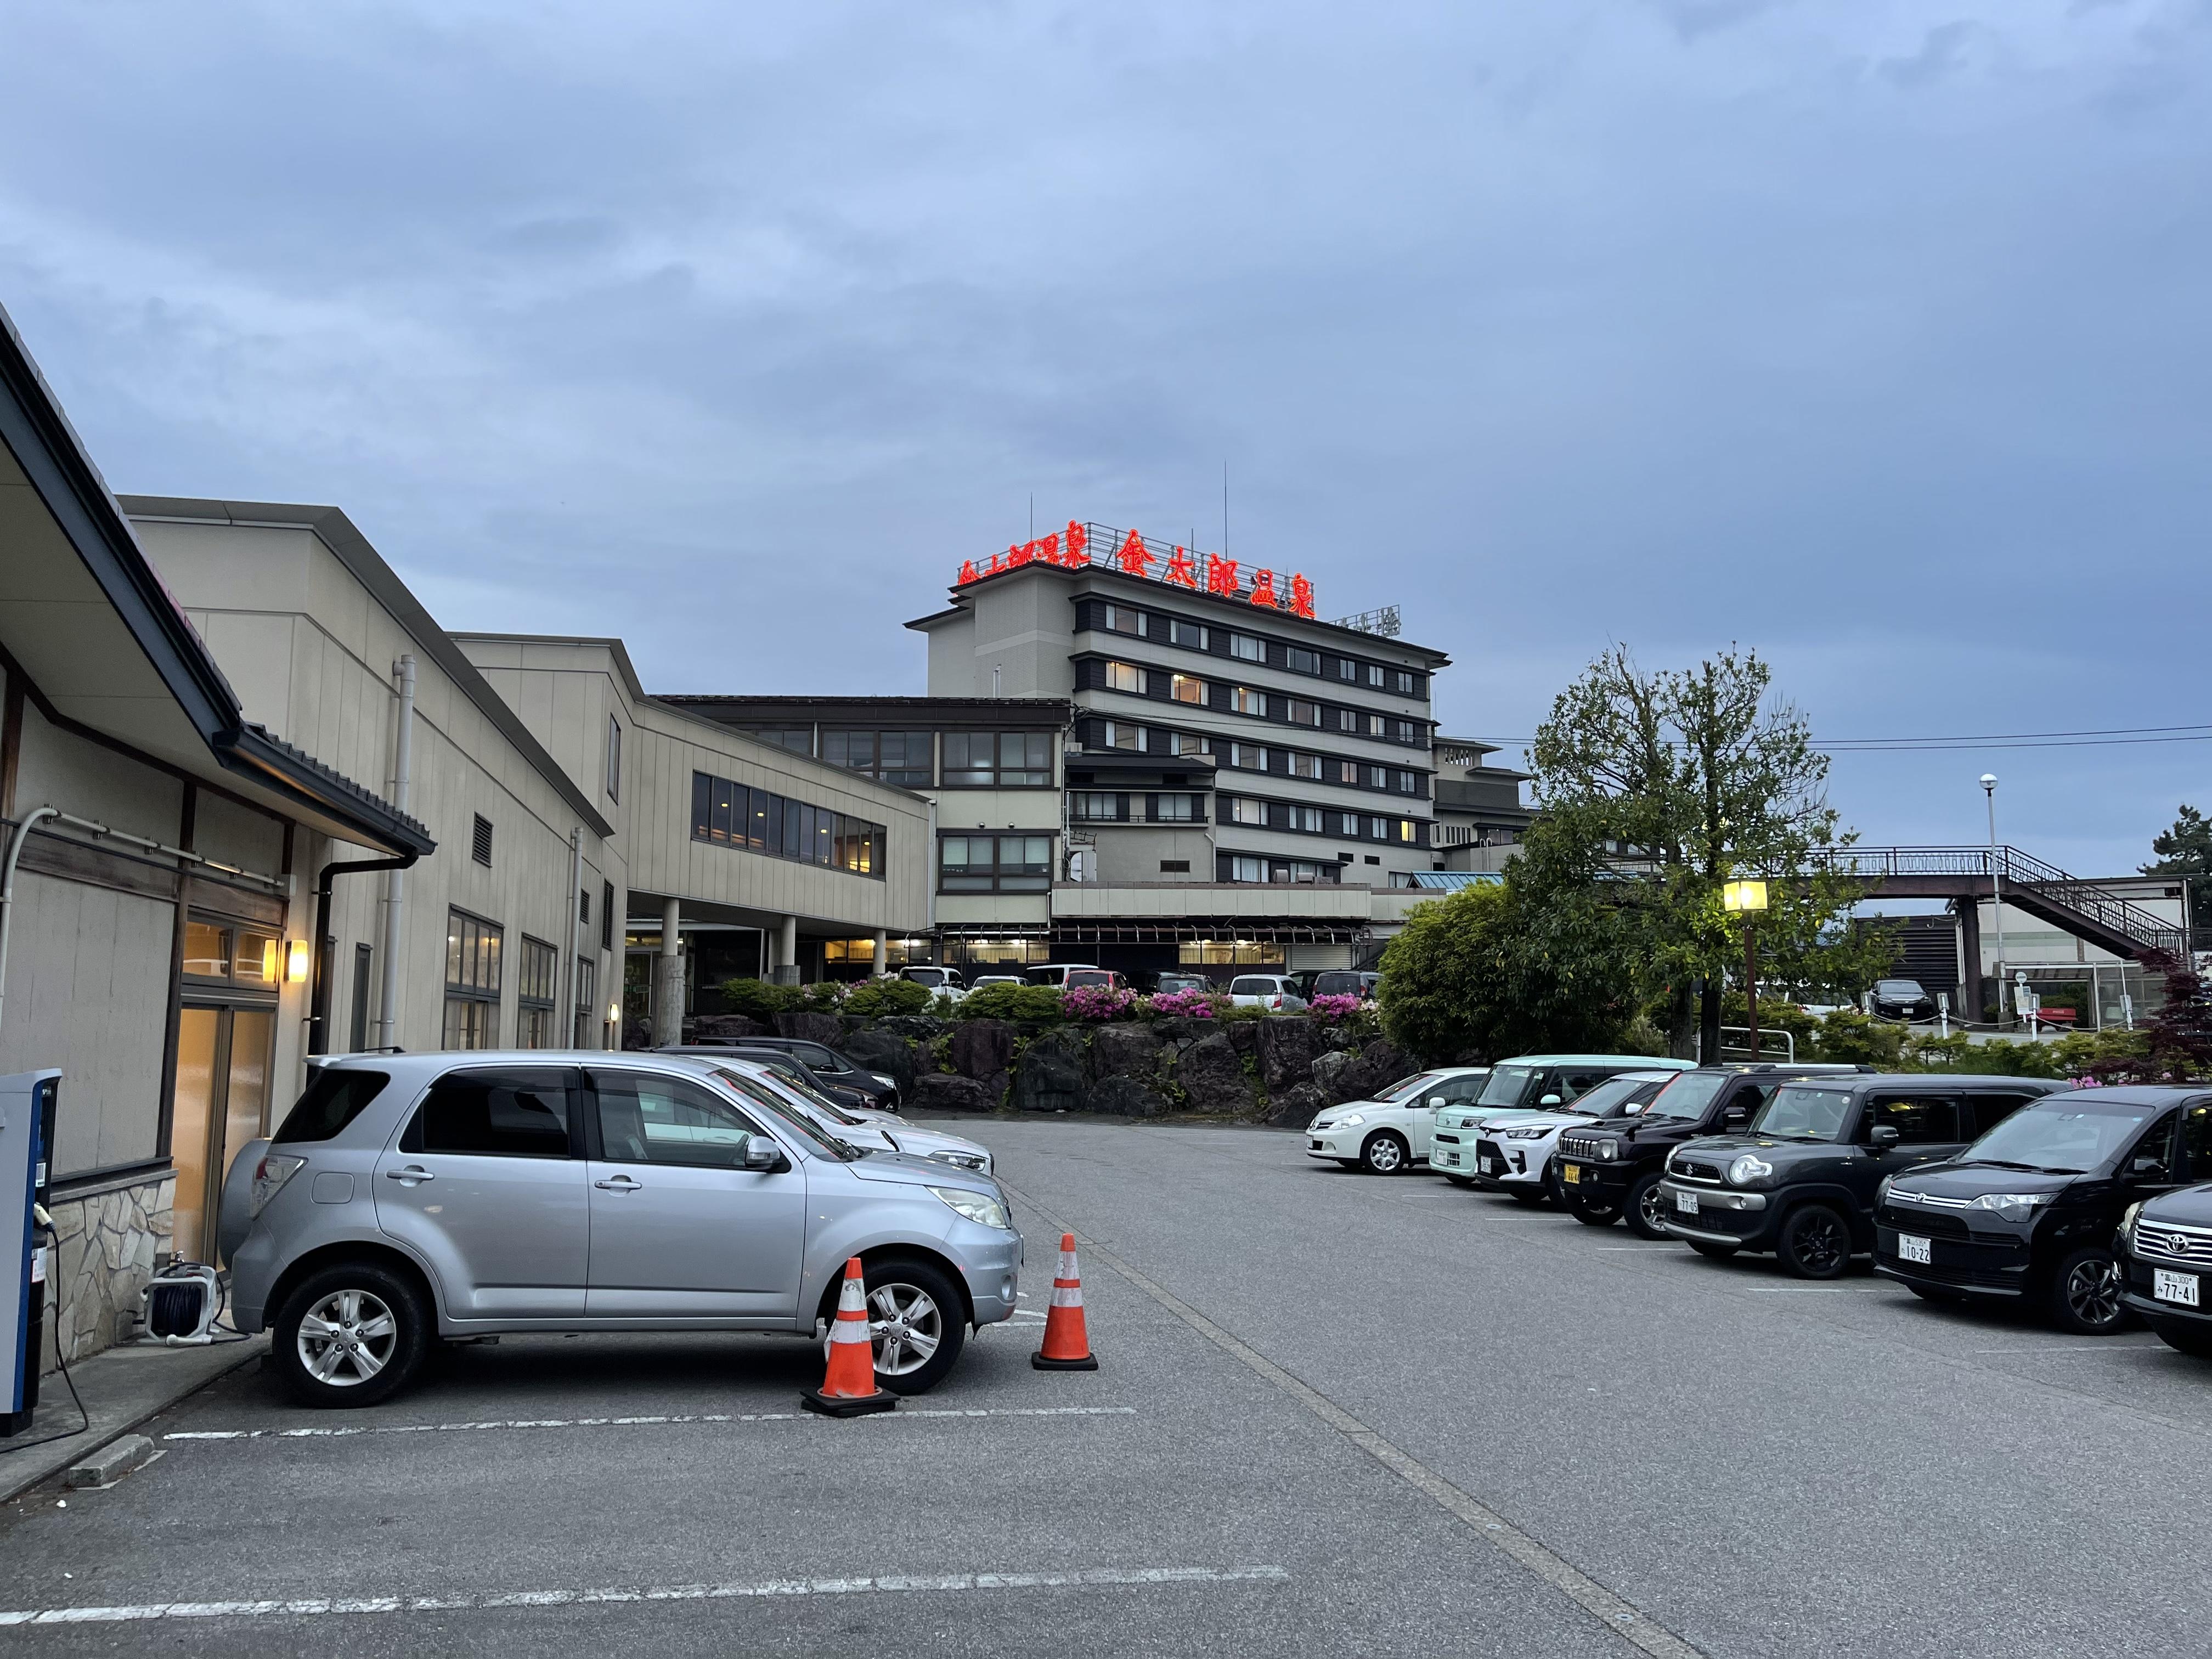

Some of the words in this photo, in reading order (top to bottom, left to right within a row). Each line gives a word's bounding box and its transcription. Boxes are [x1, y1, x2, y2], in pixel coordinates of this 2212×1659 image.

[1116, 529, 1317, 618] 金太郎温泉
[1681, 1199, 1697, 1212] 77-05
[1907, 1245, 1929, 1261] 10-22
[2164, 1283, 2196, 1303] 77-41
